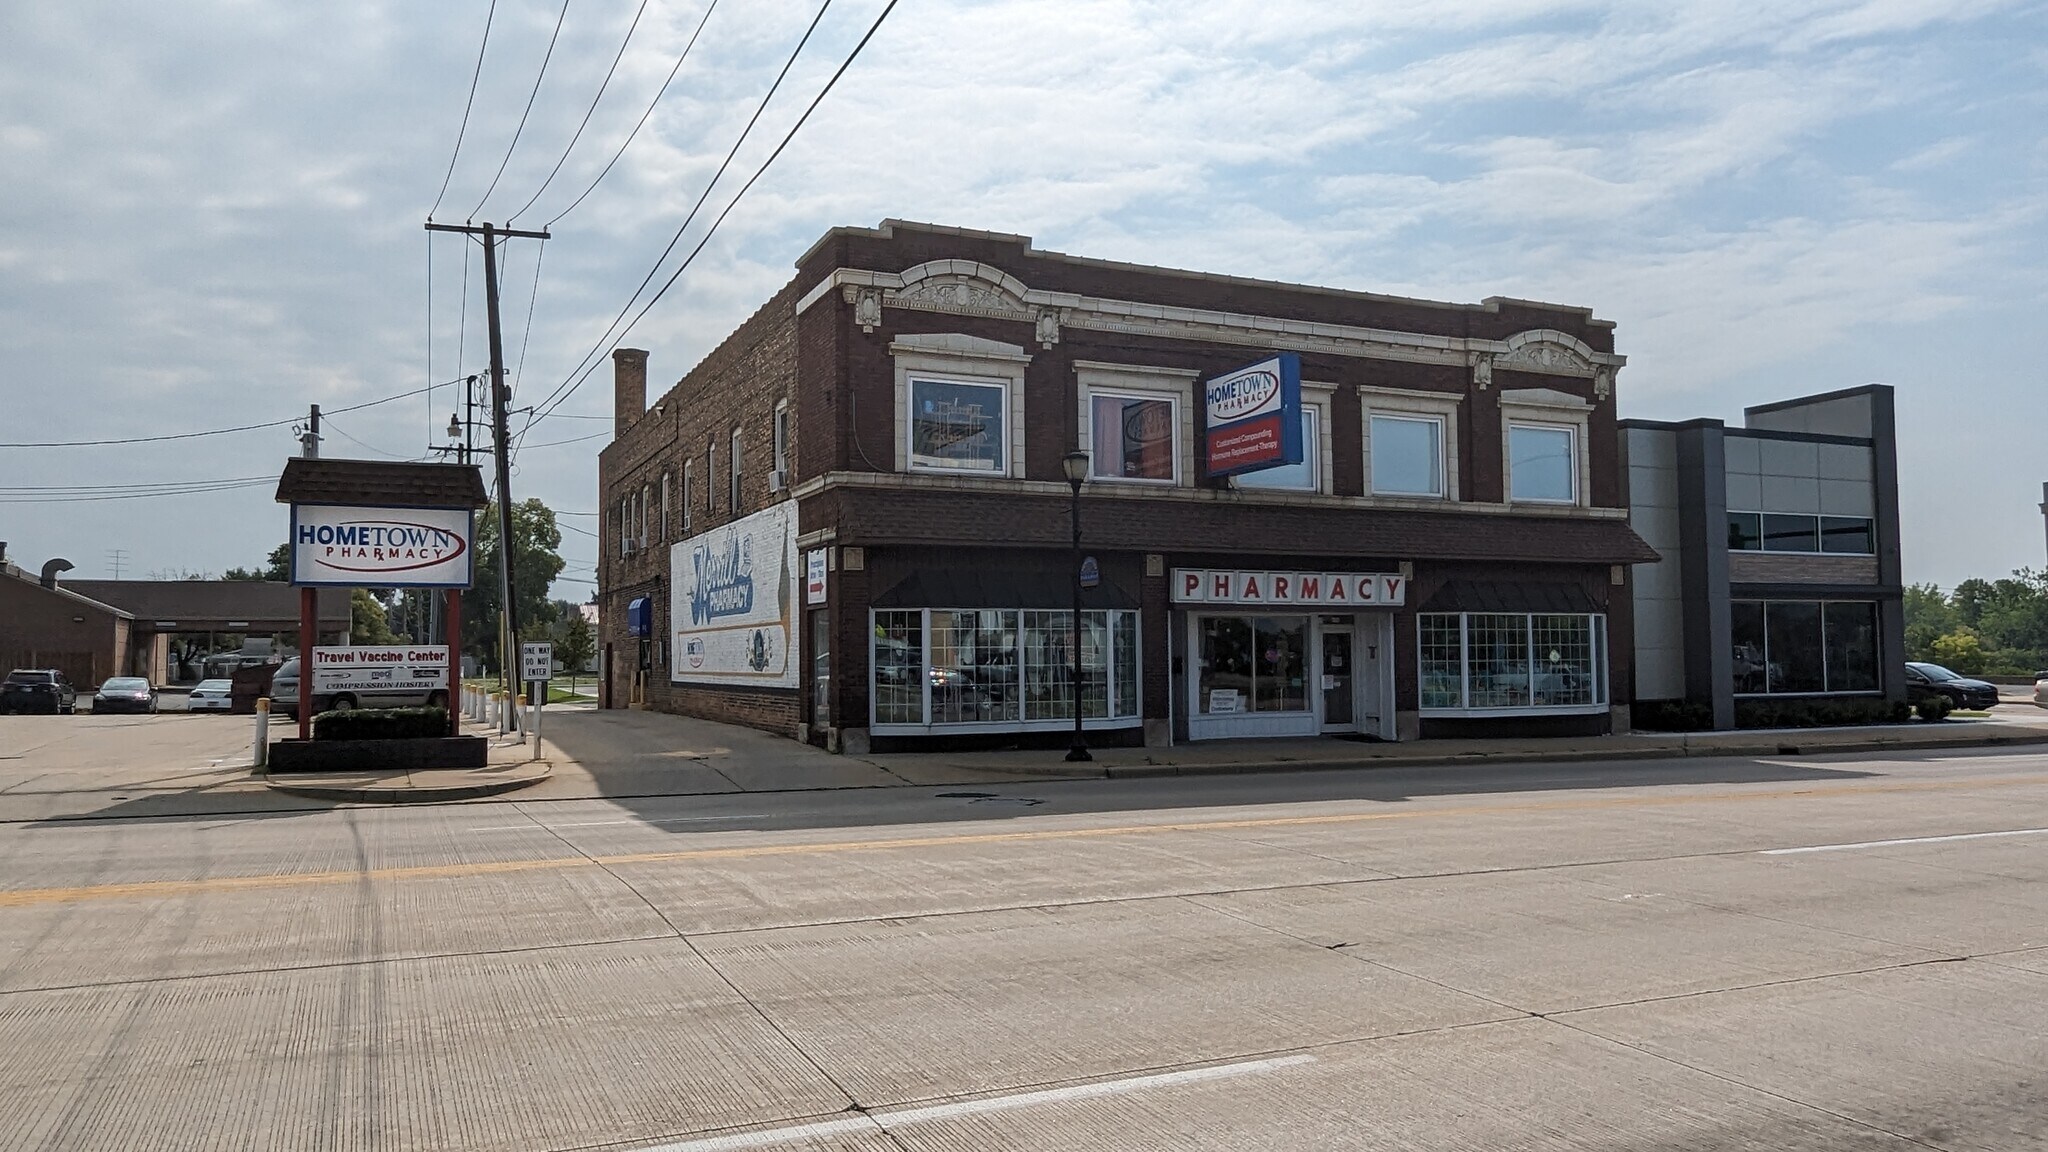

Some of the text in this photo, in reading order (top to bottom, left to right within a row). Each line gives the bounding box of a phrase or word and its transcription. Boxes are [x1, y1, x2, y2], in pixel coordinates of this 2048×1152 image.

[1208, 374, 1271, 405] HOMETOWN
[1218, 391, 1269, 412] PHARMACY
[299, 525, 451, 548] HOMETOWN
[326, 547, 443, 561] PHARMACY
[1185, 574, 1400, 599] PHARMACY
[710, 584, 749, 613] PHARMACY
[317, 650, 445, 663] Travel Vaccine Center
[525, 657, 549, 666] DO NOT
[528, 668, 547, 676] ENTER
[325, 682, 394, 690] COMPRESSION
